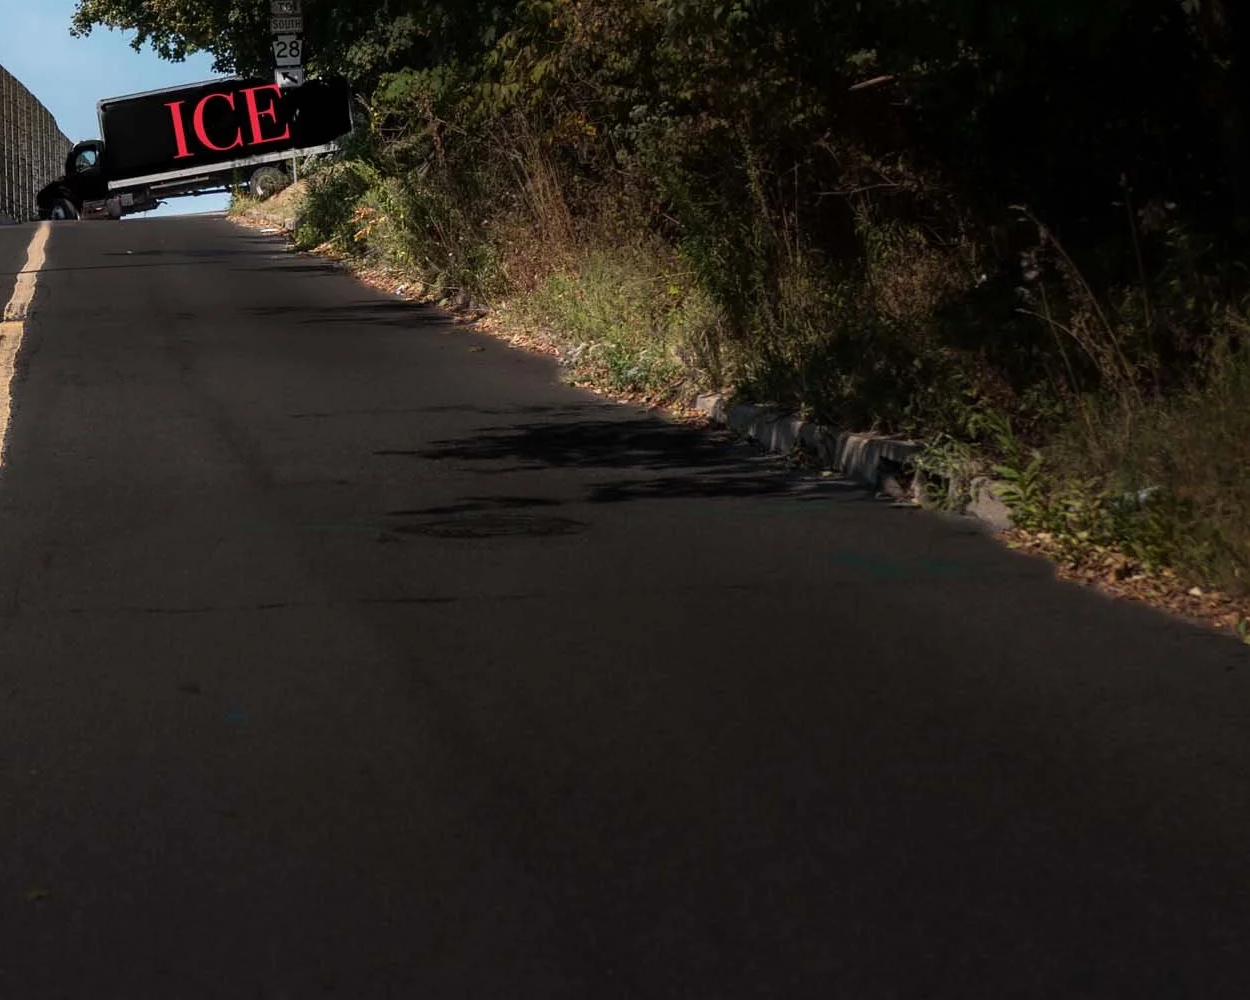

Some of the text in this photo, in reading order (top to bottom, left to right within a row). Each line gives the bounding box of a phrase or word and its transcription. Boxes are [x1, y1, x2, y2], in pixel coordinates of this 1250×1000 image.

[272, 19, 301, 29] SOUTH
[276, 40, 300, 58] 28
[164, 83, 291, 159] ICE
